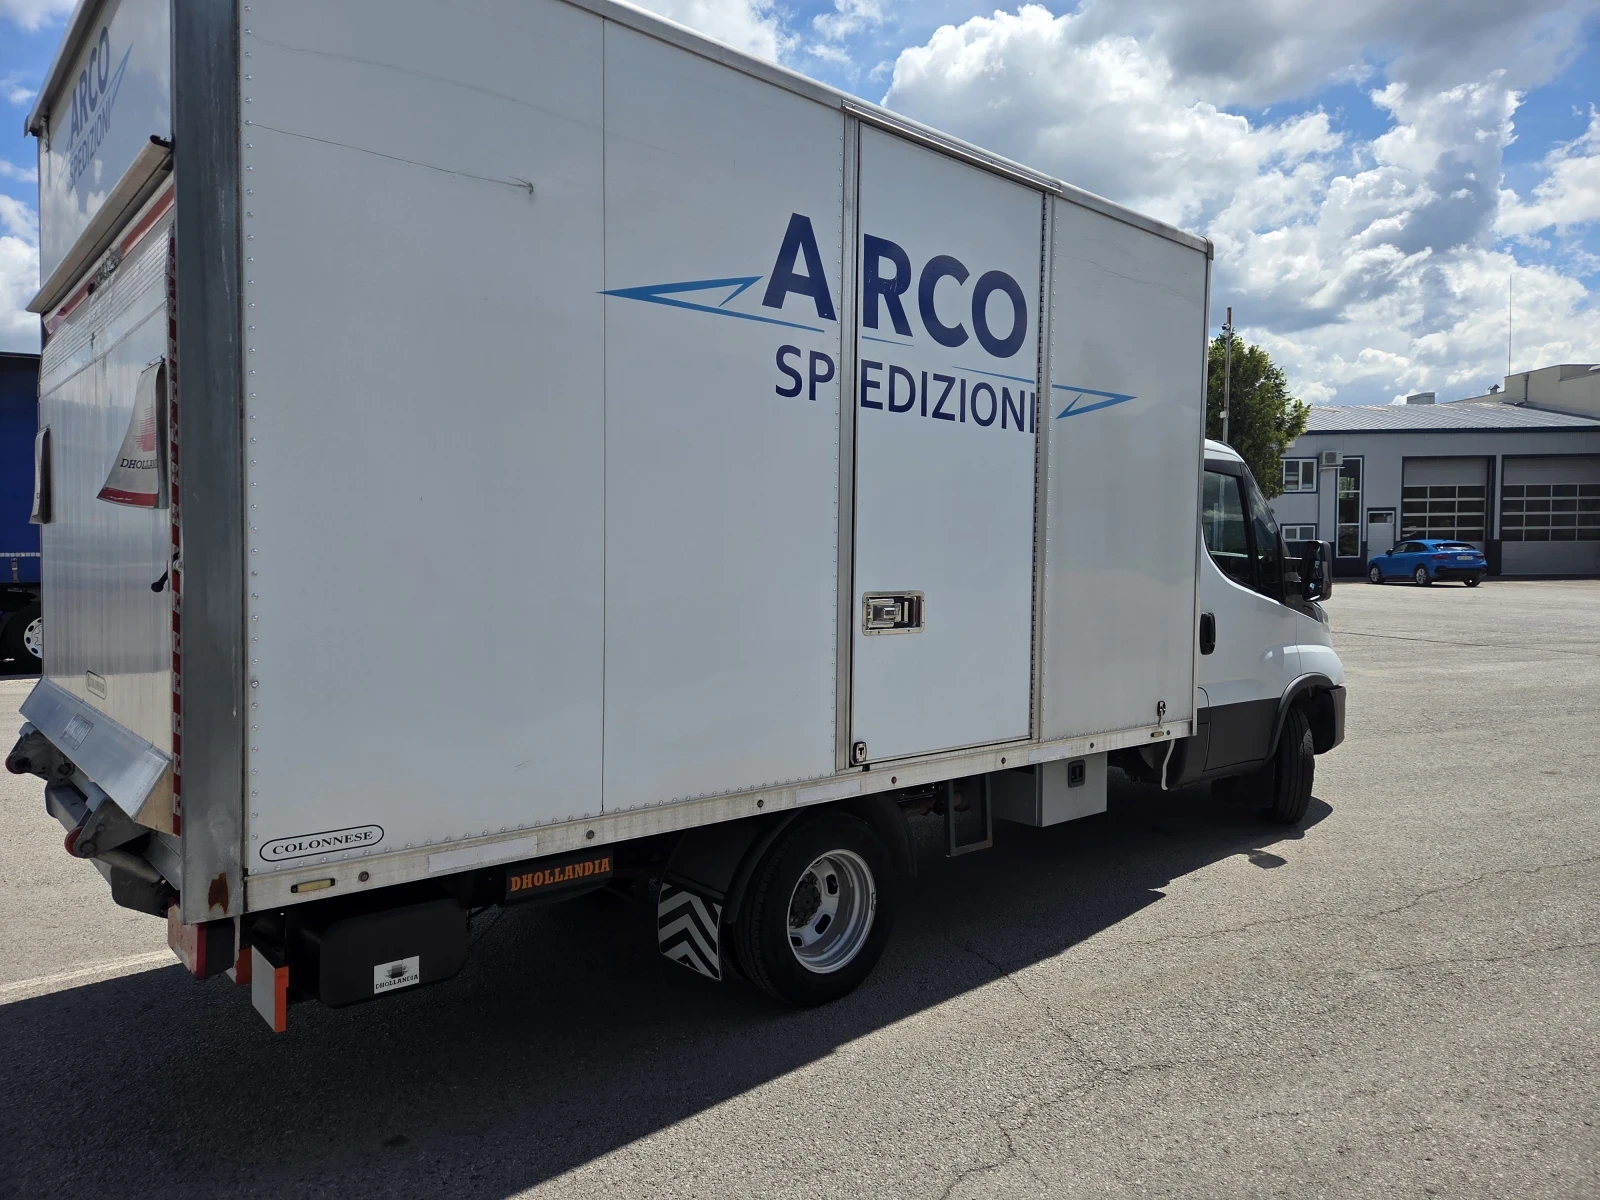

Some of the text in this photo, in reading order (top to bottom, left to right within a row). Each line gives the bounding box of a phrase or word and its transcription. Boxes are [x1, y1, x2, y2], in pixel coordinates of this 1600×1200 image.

[70, 26, 110, 149] ARCO
[69, 96, 111, 189] SPEDIZIONI
[762, 212, 1028, 358] ARCO
[775, 344, 1035, 434] SPEDIZIONI
[272, 831, 373, 855] COLONNESE
[510, 858, 611, 892] DHOLLANDIA
[375, 974, 419, 990] DHOLLANDIA
